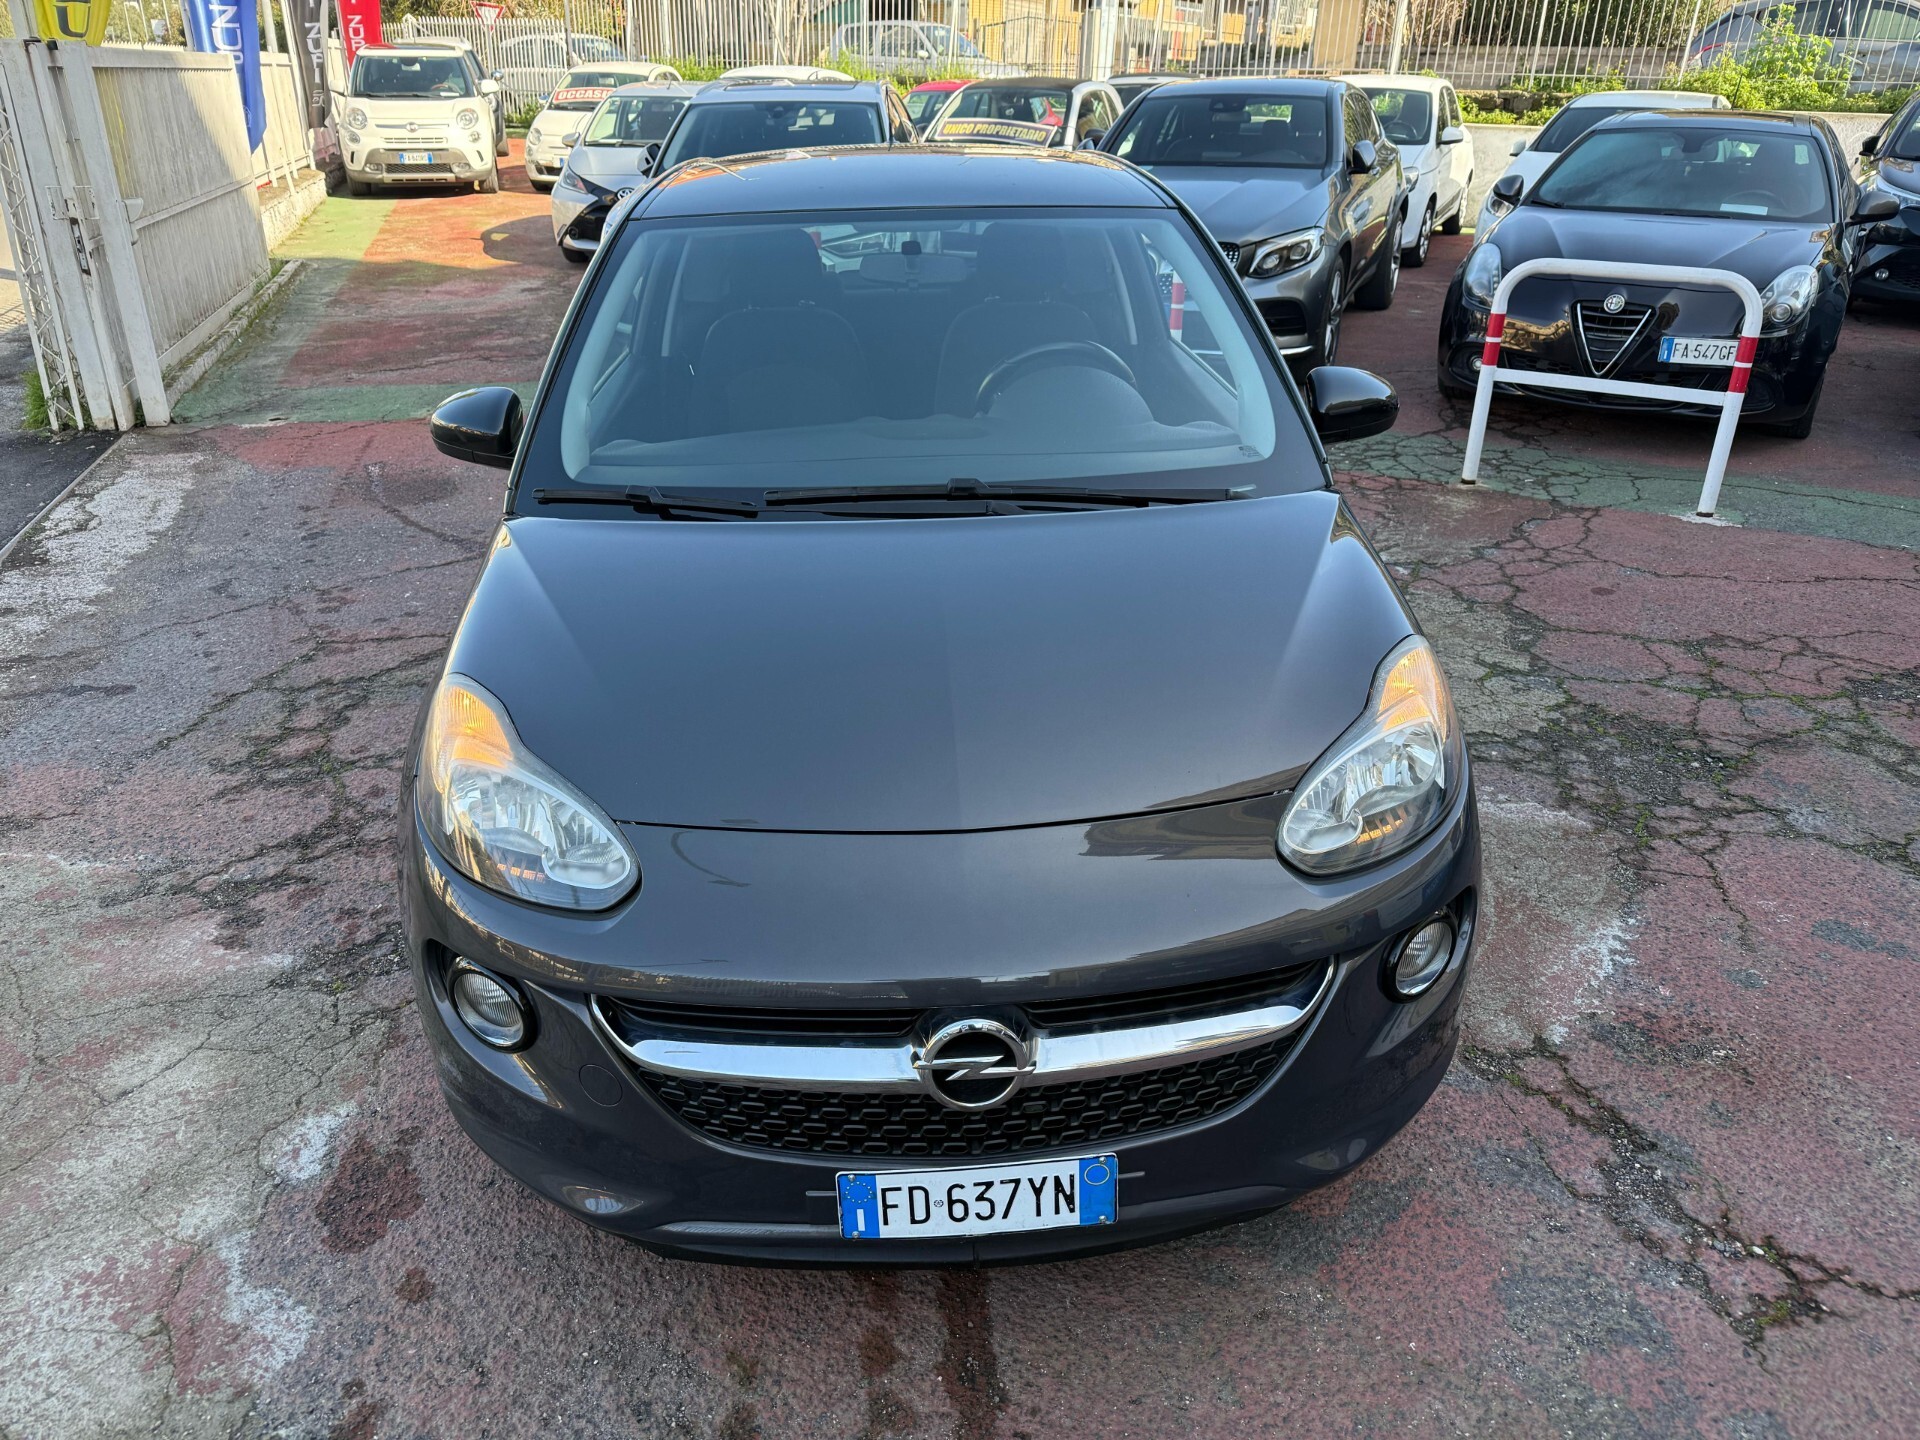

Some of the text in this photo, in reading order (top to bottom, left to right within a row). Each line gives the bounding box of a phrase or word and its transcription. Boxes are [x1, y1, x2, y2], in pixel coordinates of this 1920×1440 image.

[557, 88, 614, 100] OCCASI
[942, 123, 1047, 142] UNICO PROPRIETARIO
[880, 1185, 931, 1226] FD
[946, 1173, 1077, 1223] 637YN
